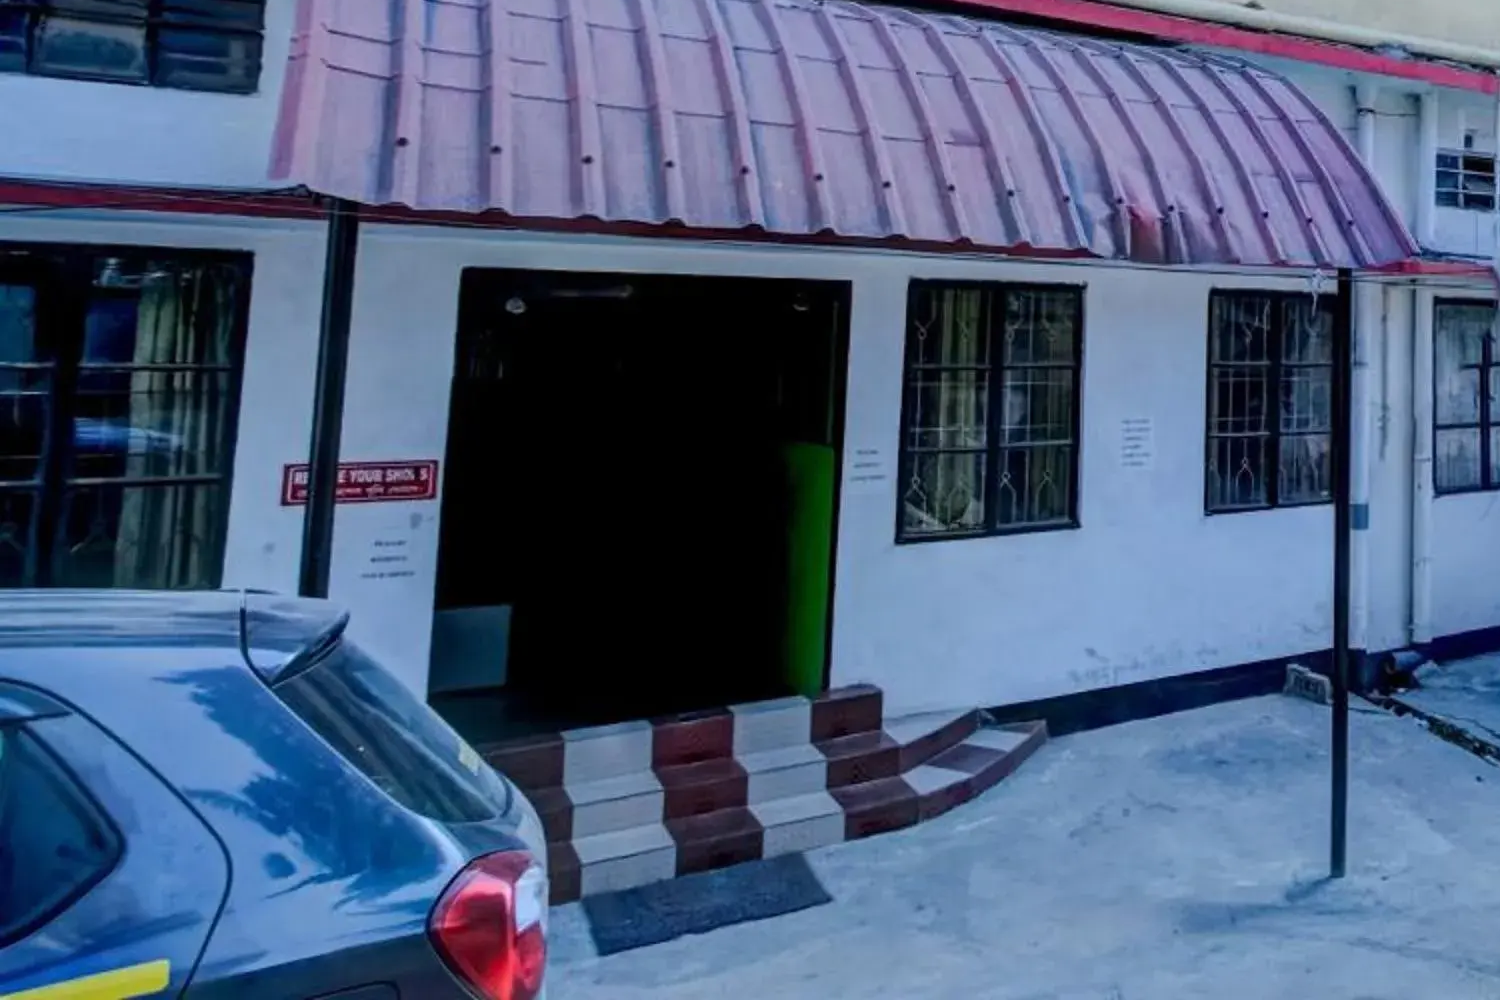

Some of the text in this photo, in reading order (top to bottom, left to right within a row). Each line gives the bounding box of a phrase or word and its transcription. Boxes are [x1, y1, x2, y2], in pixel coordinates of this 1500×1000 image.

[294, 468, 428, 484] REE YOUR SHOS
